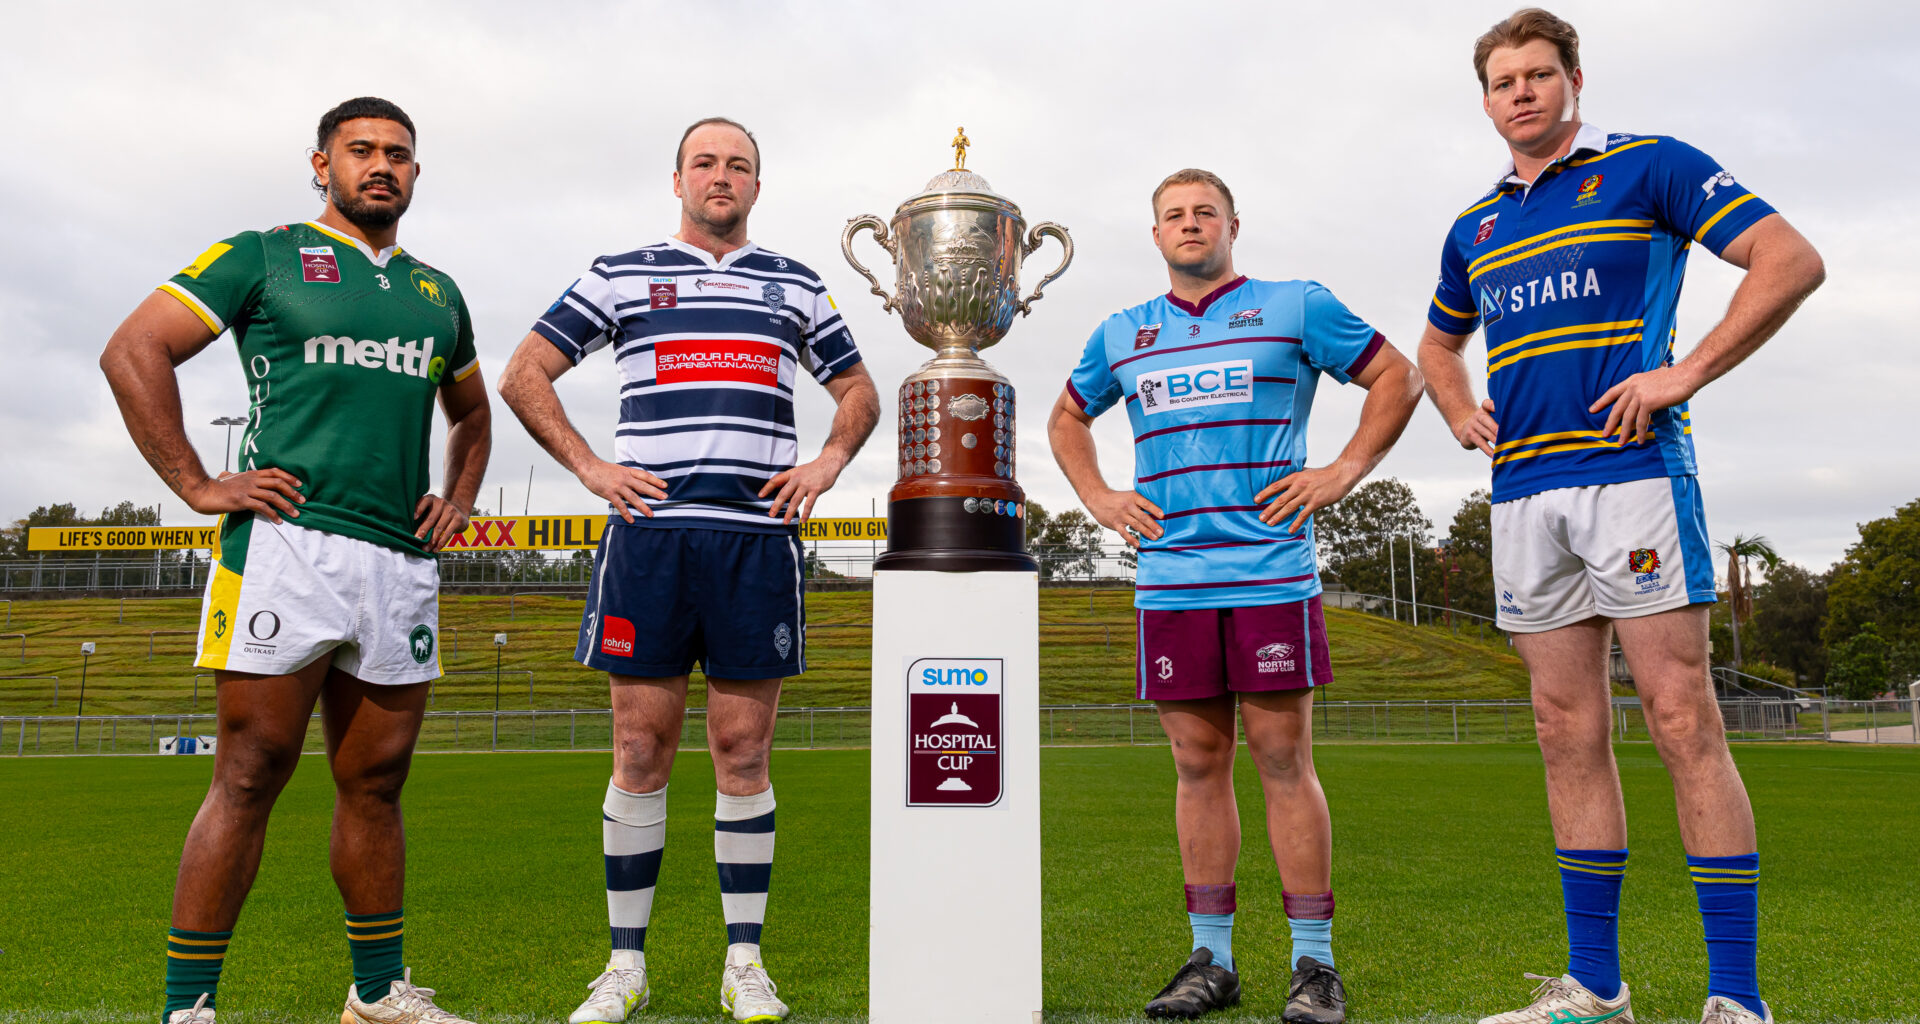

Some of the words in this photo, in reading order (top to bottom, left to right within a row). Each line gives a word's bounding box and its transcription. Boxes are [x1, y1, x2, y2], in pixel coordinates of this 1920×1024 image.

[721, 282, 750, 290] NORTHERN
[1511, 268, 1601, 313] STARA
[1229, 317, 1263, 326] NORTHS
[304, 335, 446, 384] mettle
[659, 352, 721, 364] SEYMOUR
[724, 352, 777, 367] FURLONG
[658, 361, 735, 372] COMPENSATION
[735, 362, 778, 375] LAWYERS
[1166, 365, 1249, 397] BCE
[528, 519, 600, 547] HILL
[833, 521, 862, 537] YOU
[59, 531, 102, 547] LIFE'S
[107, 531, 146, 546] GOOD
[151, 530, 193, 545] WHEN
[1500, 604, 1524, 615] oneills
[244, 647, 276, 655] OUTKAST
[603, 637, 632, 652] rohrig
[1258, 659, 1295, 669] NORTHS
[922, 668, 988, 686] sumo
[914, 733, 996, 749] HOSPITAL
[937, 755, 974, 770] CUP
